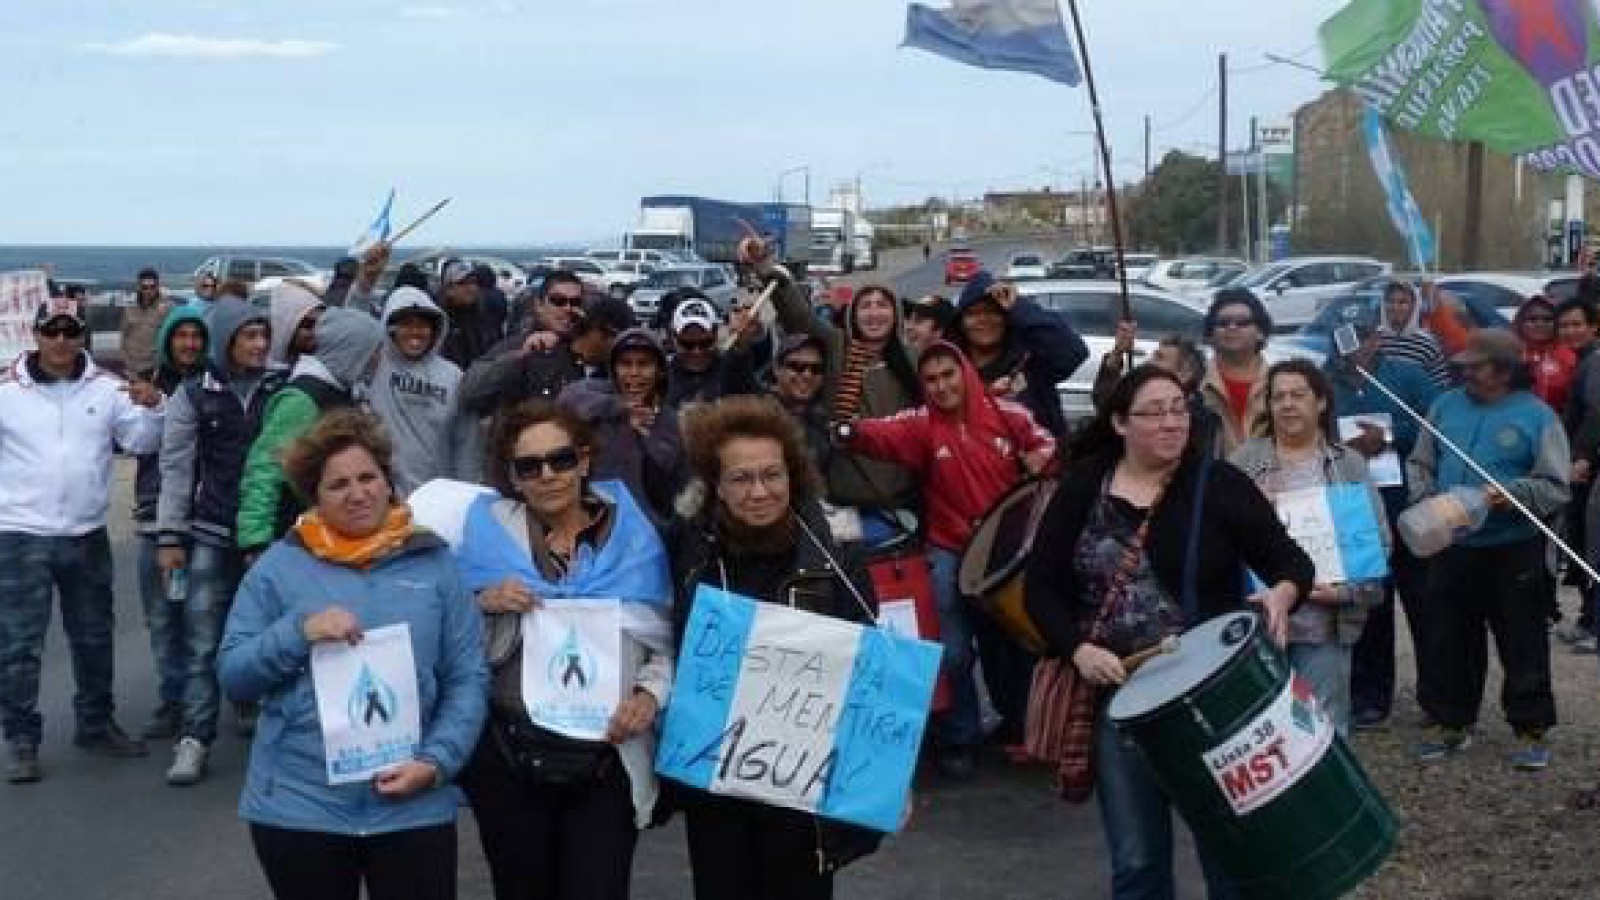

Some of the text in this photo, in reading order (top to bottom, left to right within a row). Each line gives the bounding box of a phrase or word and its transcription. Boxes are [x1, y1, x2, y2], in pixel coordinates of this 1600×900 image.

[694, 610, 823, 683] BASTA
[1252, 719, 1276, 745] 38
[1221, 735, 1290, 800] MST
